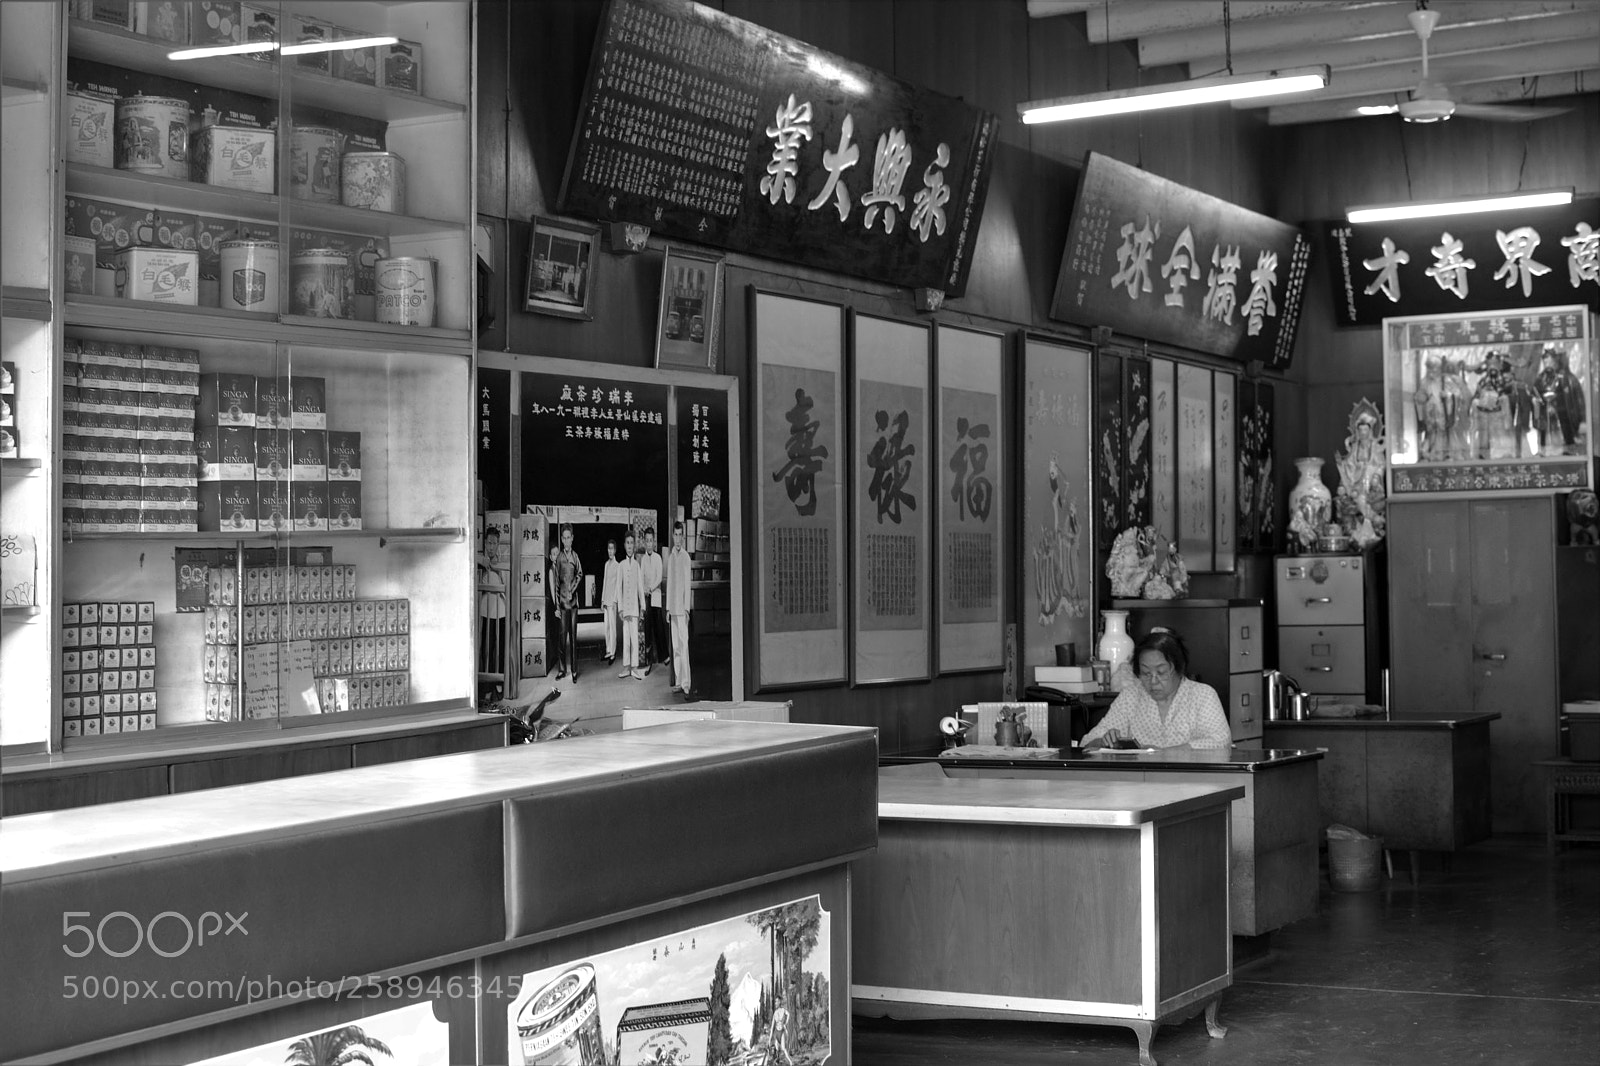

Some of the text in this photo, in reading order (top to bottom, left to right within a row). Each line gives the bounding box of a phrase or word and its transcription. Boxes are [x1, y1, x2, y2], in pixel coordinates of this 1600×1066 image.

[223, 391, 248, 399] SINGA
[261, 394, 286, 402] SINGA
[262, 446, 287, 454] SINGA
[333, 447, 355, 455] SINGA
[224, 456, 248, 464] SINGA
[949, 416, 992, 522] 福
[226, 497, 250, 505] SINGA
[263, 497, 288, 505] SINGA
[300, 497, 323, 505] SINGA
[333, 497, 356, 505] SINGA
